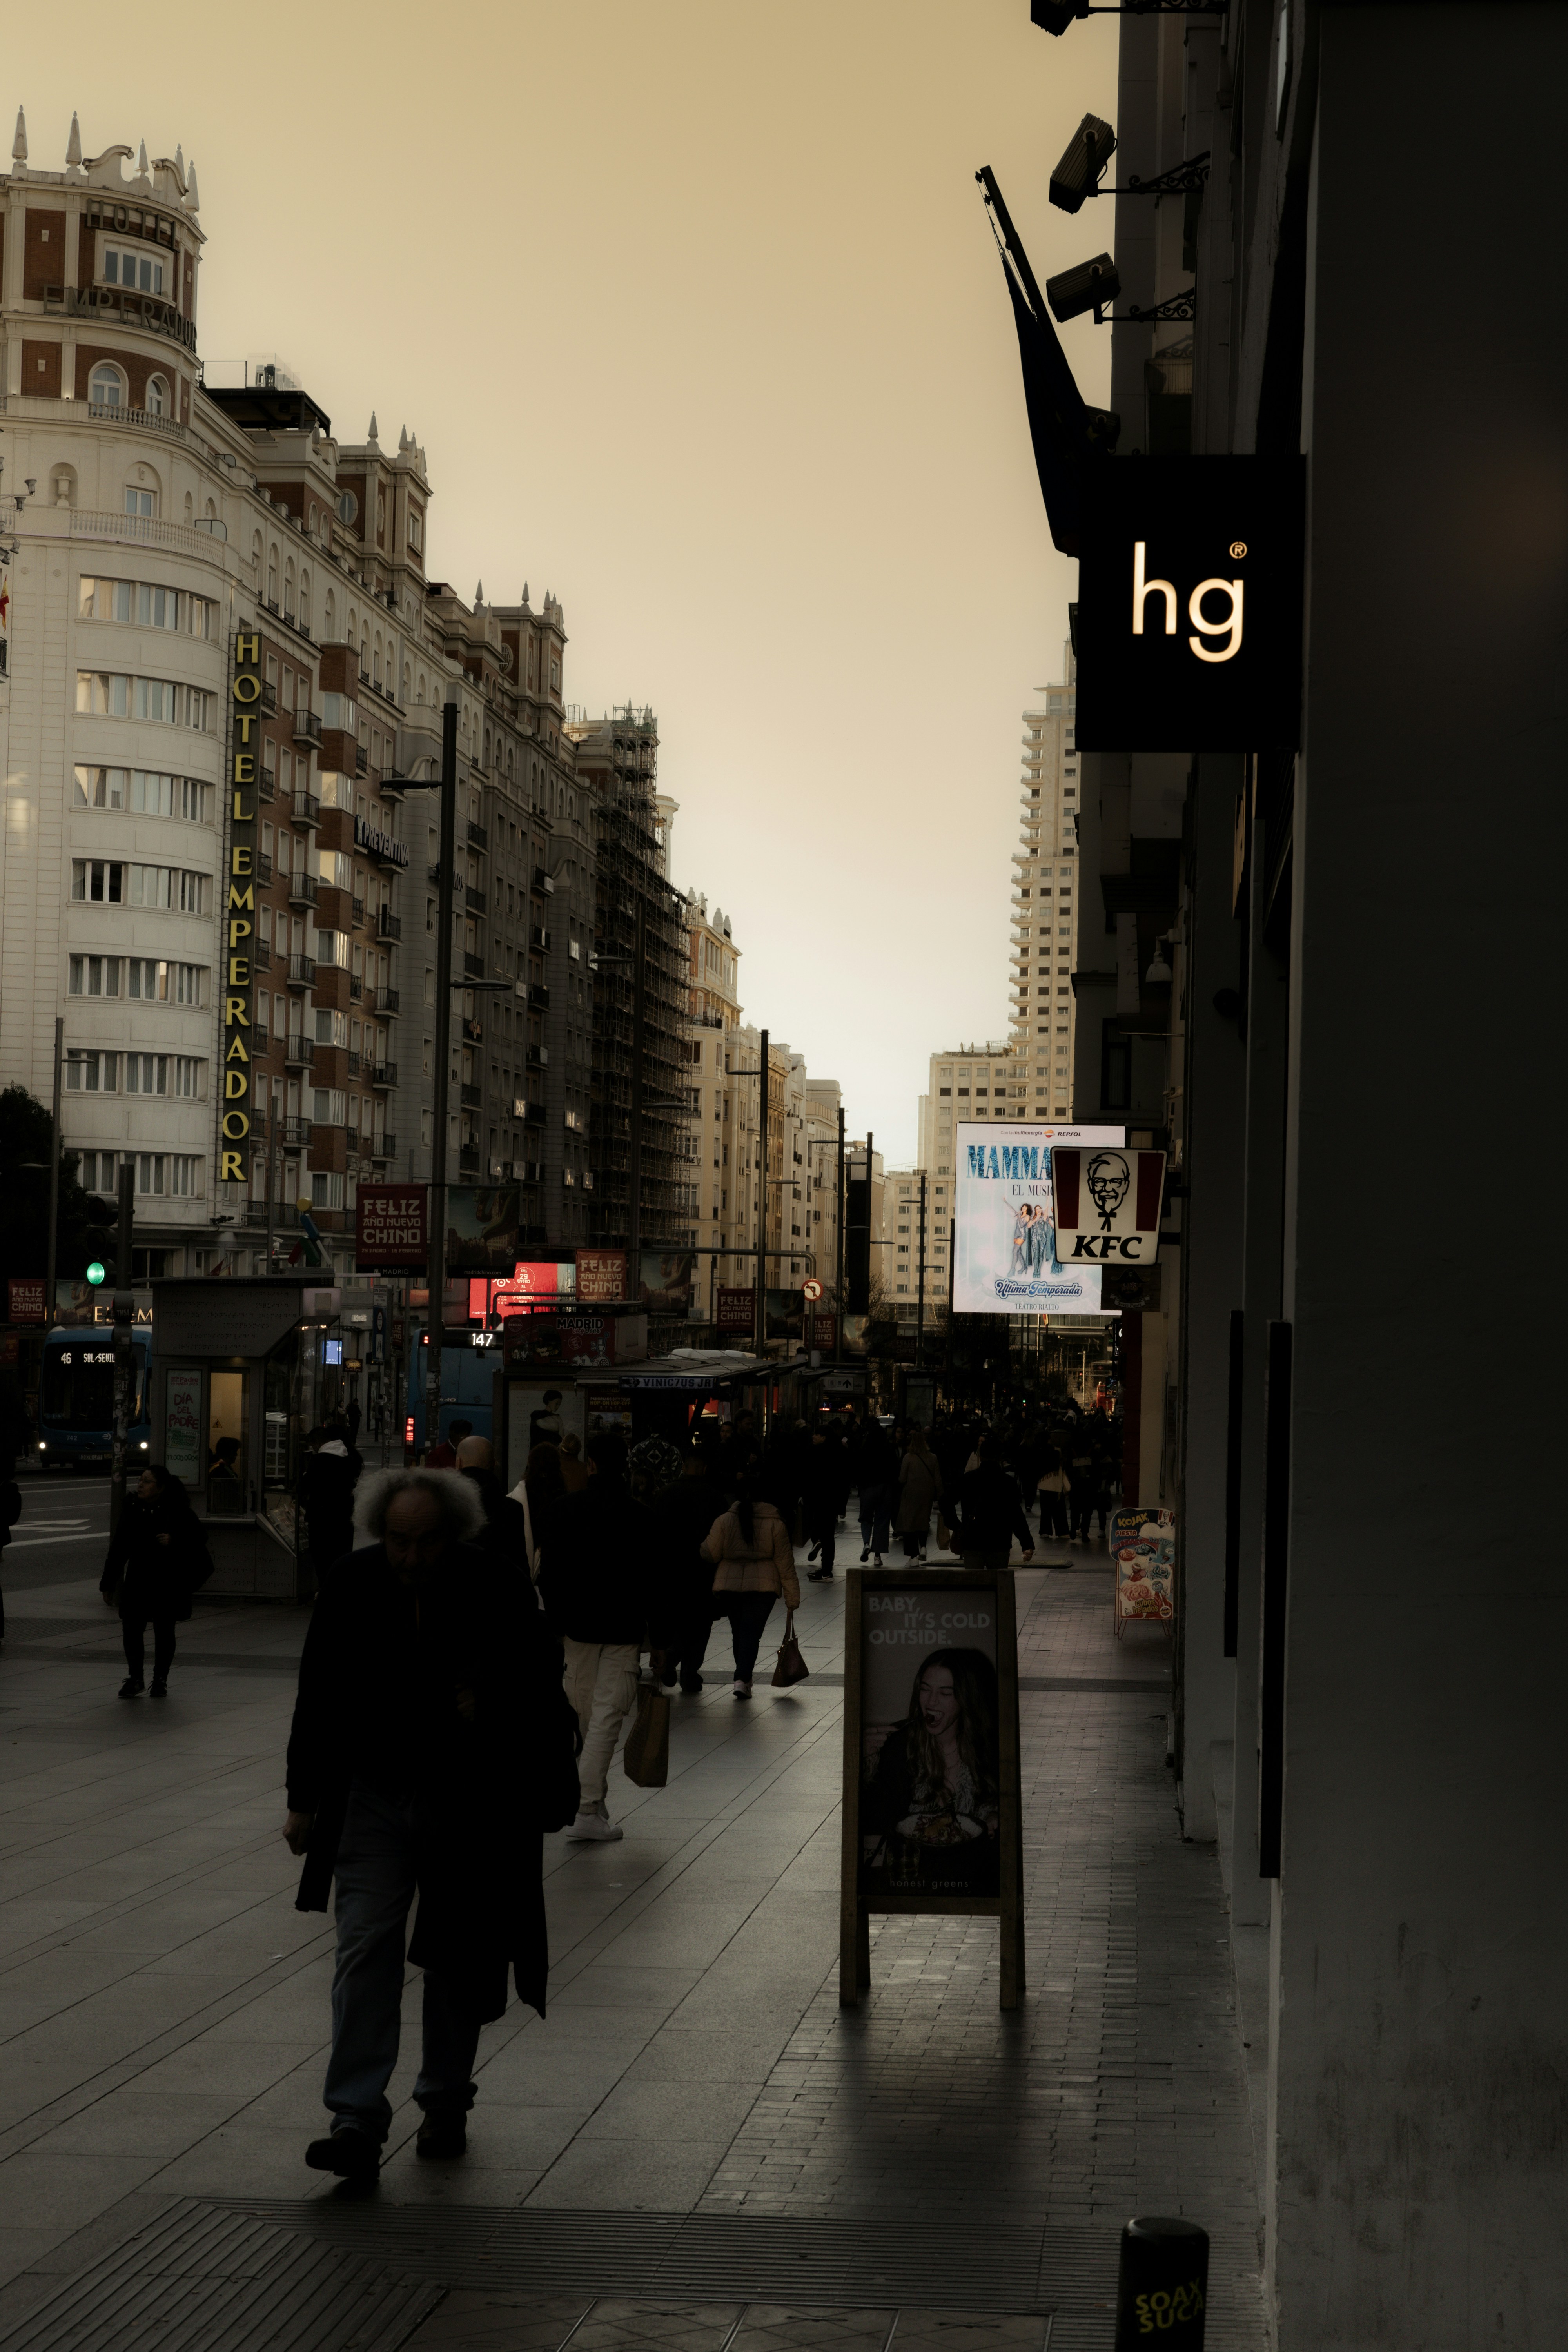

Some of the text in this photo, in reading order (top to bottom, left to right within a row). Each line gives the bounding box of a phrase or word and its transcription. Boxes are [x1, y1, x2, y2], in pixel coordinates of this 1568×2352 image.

[87, 198, 180, 253] HOTEL
[43, 284, 197, 353] EMPERADOR
[1132, 541, 1244, 663] hg
[365, 822, 409, 867] PREVENTIVA
[221, 635, 261, 1181] HOTEL EMPERADOR
[966, 1145, 1052, 1180] MAMMA
[1013, 1185, 1024, 1196] EL
[363, 1199, 421, 1216] FELIZ
[363, 1216, 421, 1227] AÑO NUEVO
[363, 1229, 421, 1244] CHINO
[1071, 1235, 1142, 1259] KFC
[581, 1259, 622, 1272] FELIZ
[580, 1272, 595, 1280] AÑO
[12, 1287, 42, 1297] FELIZ
[580, 1281, 622, 1292] CHINO
[996, 1279, 1082, 1298] Última Temporada
[720, 1296, 751, 1305] FELIZ
[11, 1303, 42, 1312] CHINO
[720, 1312, 751, 1320] CHINO
[557, 1318, 604, 1329] MADRID
[472, 1333, 493, 1346] 147
[61, 1352, 72, 1364] 46
[643, 1378, 711, 1387] VINIC7US JR
[174, 1392, 194, 1406] DÍA
[168, 1413, 199, 1430] PADRE
[1117, 1512, 1149, 1528] KOJAK
[1149, 1537, 1175, 1547] BATIDO
[869, 1597, 921, 1615] BABY,
[1132, 1605, 1159, 1615] helados
[904, 1613, 991, 1628] IT'S COLD
[869, 1630, 952, 1645] OUTSIDE.
[889, 1878, 969, 1889] honest greens
